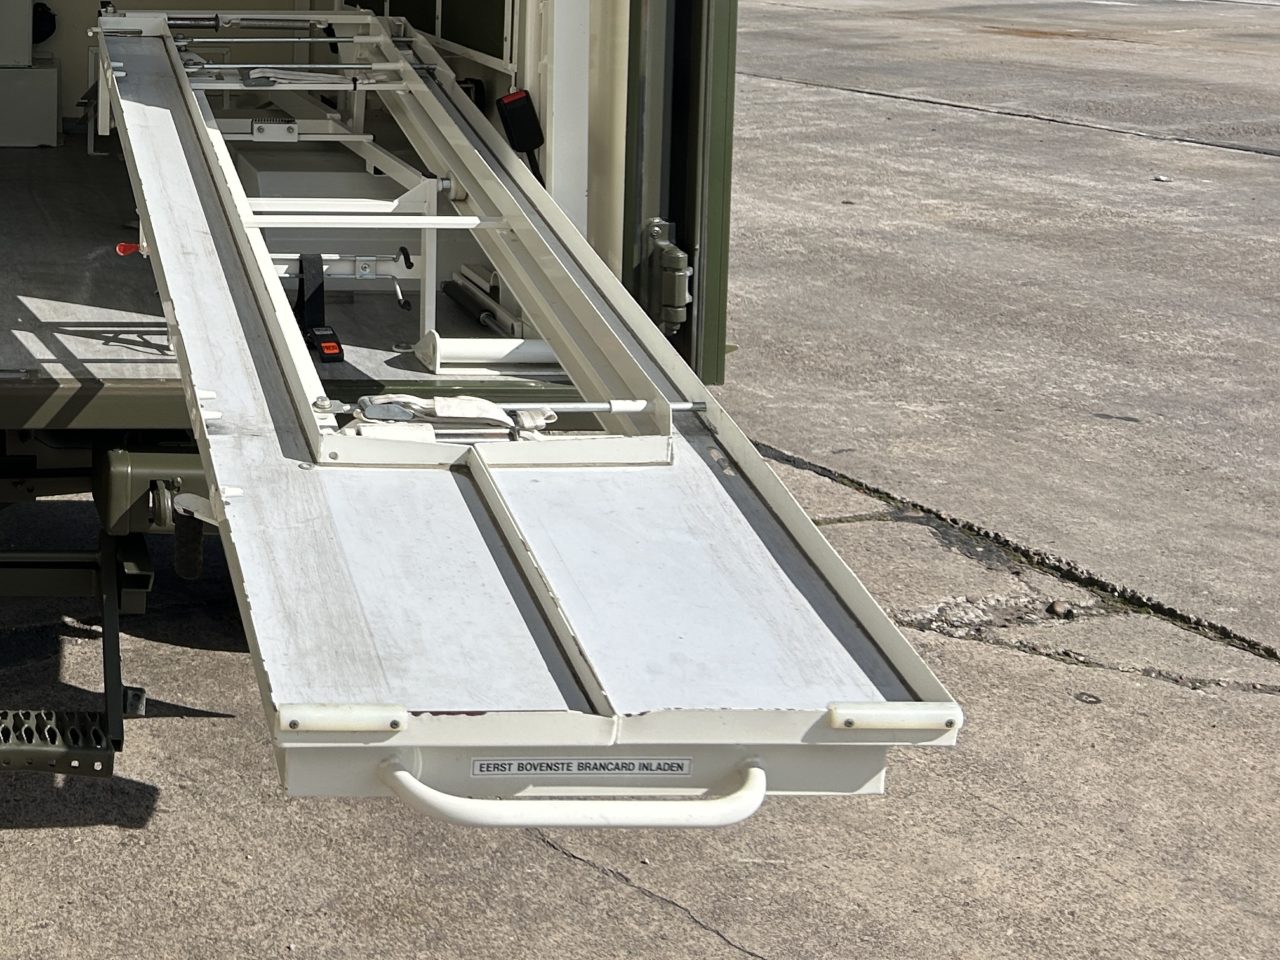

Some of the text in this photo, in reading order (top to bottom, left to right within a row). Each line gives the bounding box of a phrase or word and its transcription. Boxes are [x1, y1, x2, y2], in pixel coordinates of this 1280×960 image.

[479, 762, 684, 772] EERST BOVENSTE BRANCARD INLADEN
